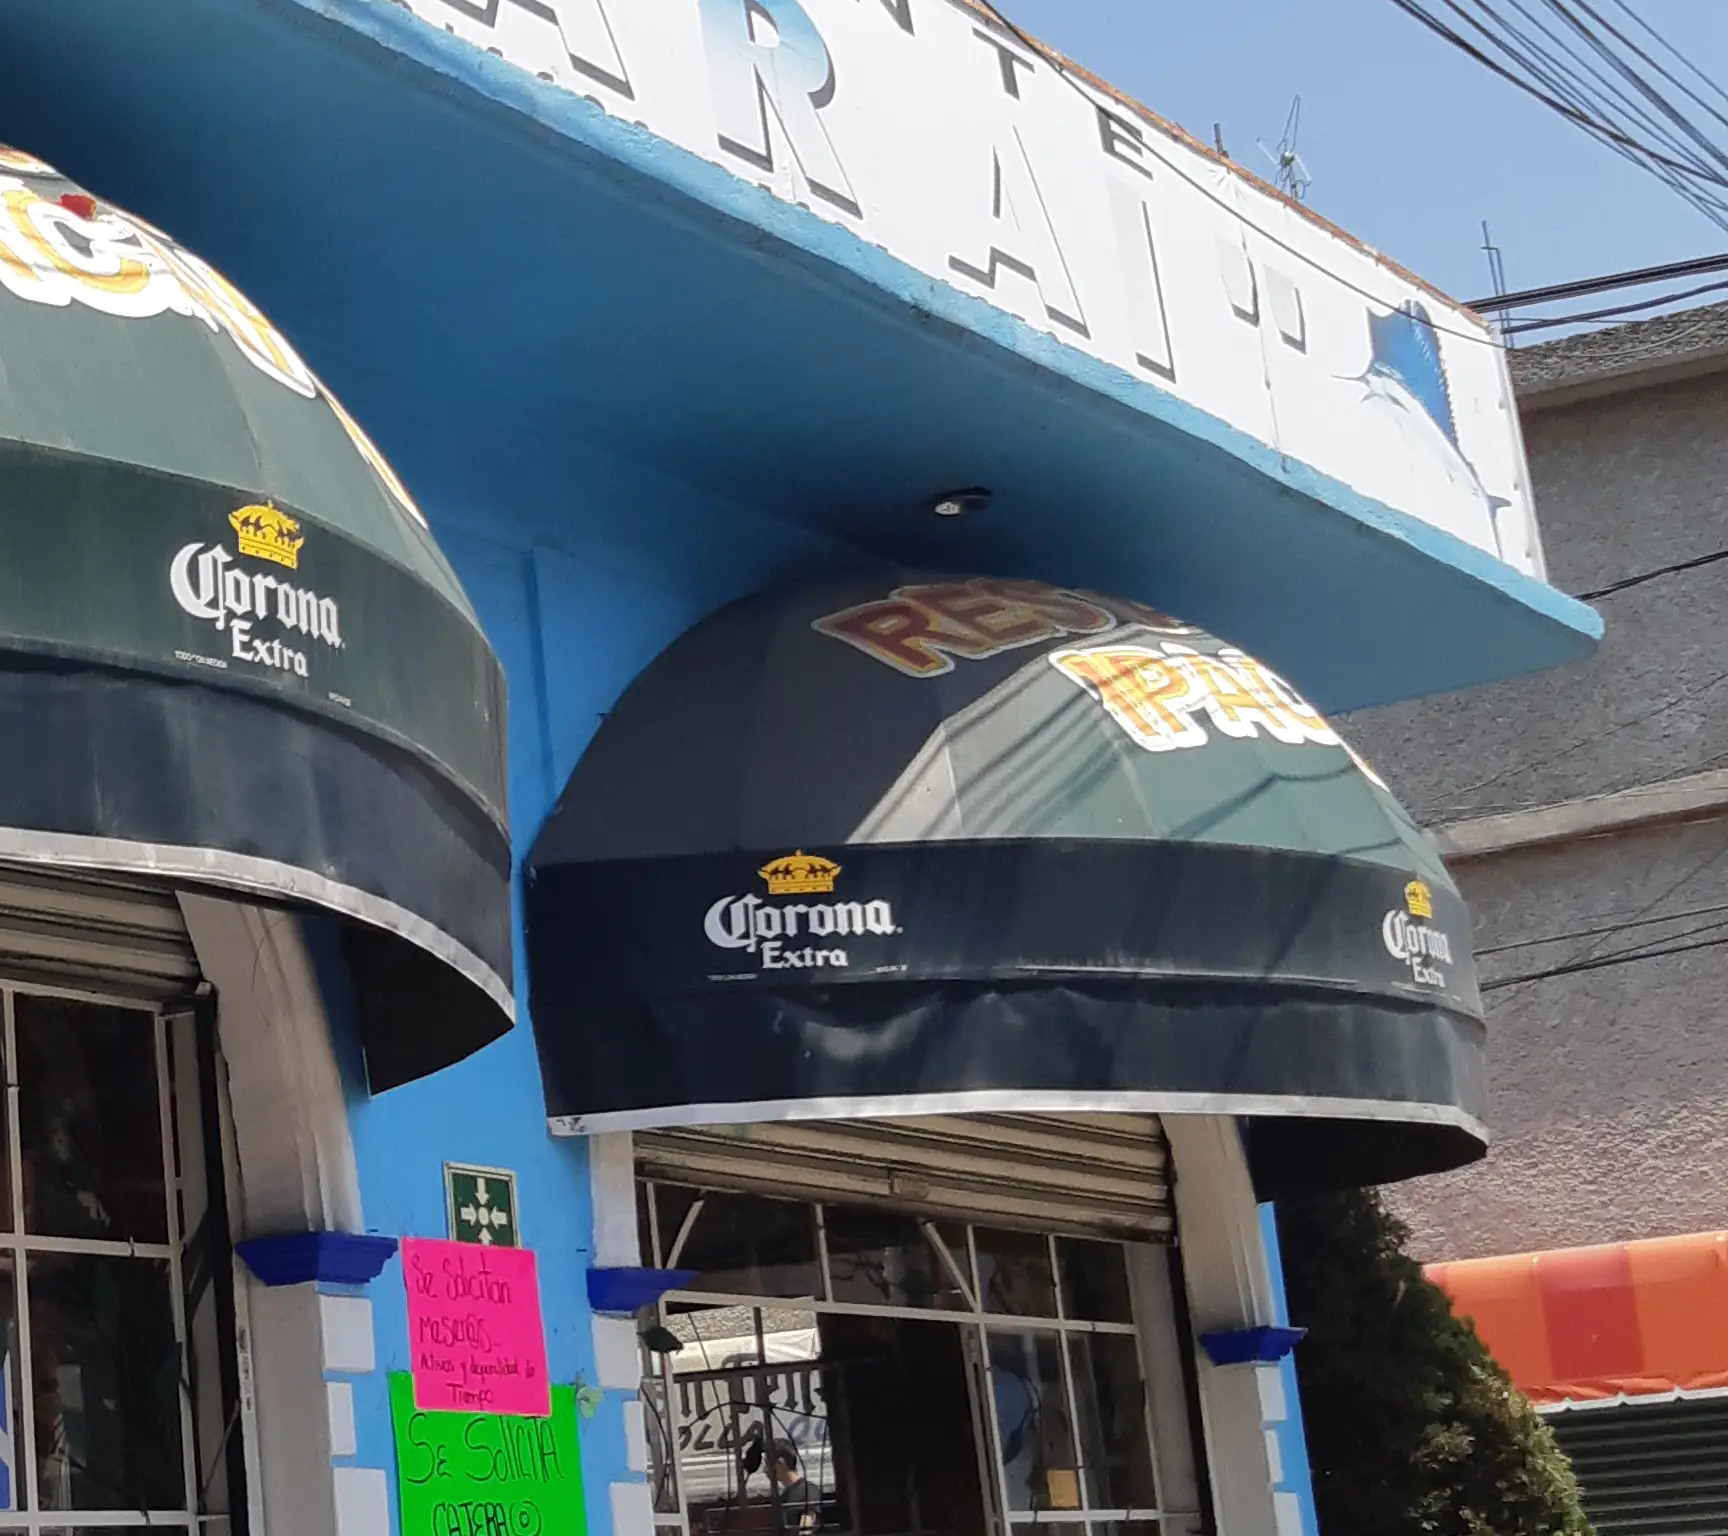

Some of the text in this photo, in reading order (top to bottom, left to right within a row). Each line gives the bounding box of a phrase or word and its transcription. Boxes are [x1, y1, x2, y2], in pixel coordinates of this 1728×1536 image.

[170, 542, 342, 649] Corona
[230, 619, 310, 677] Extra
[704, 893, 896, 953] Corona
[761, 941, 849, 969] Extra
[411, 1253, 437, 1298] Se
